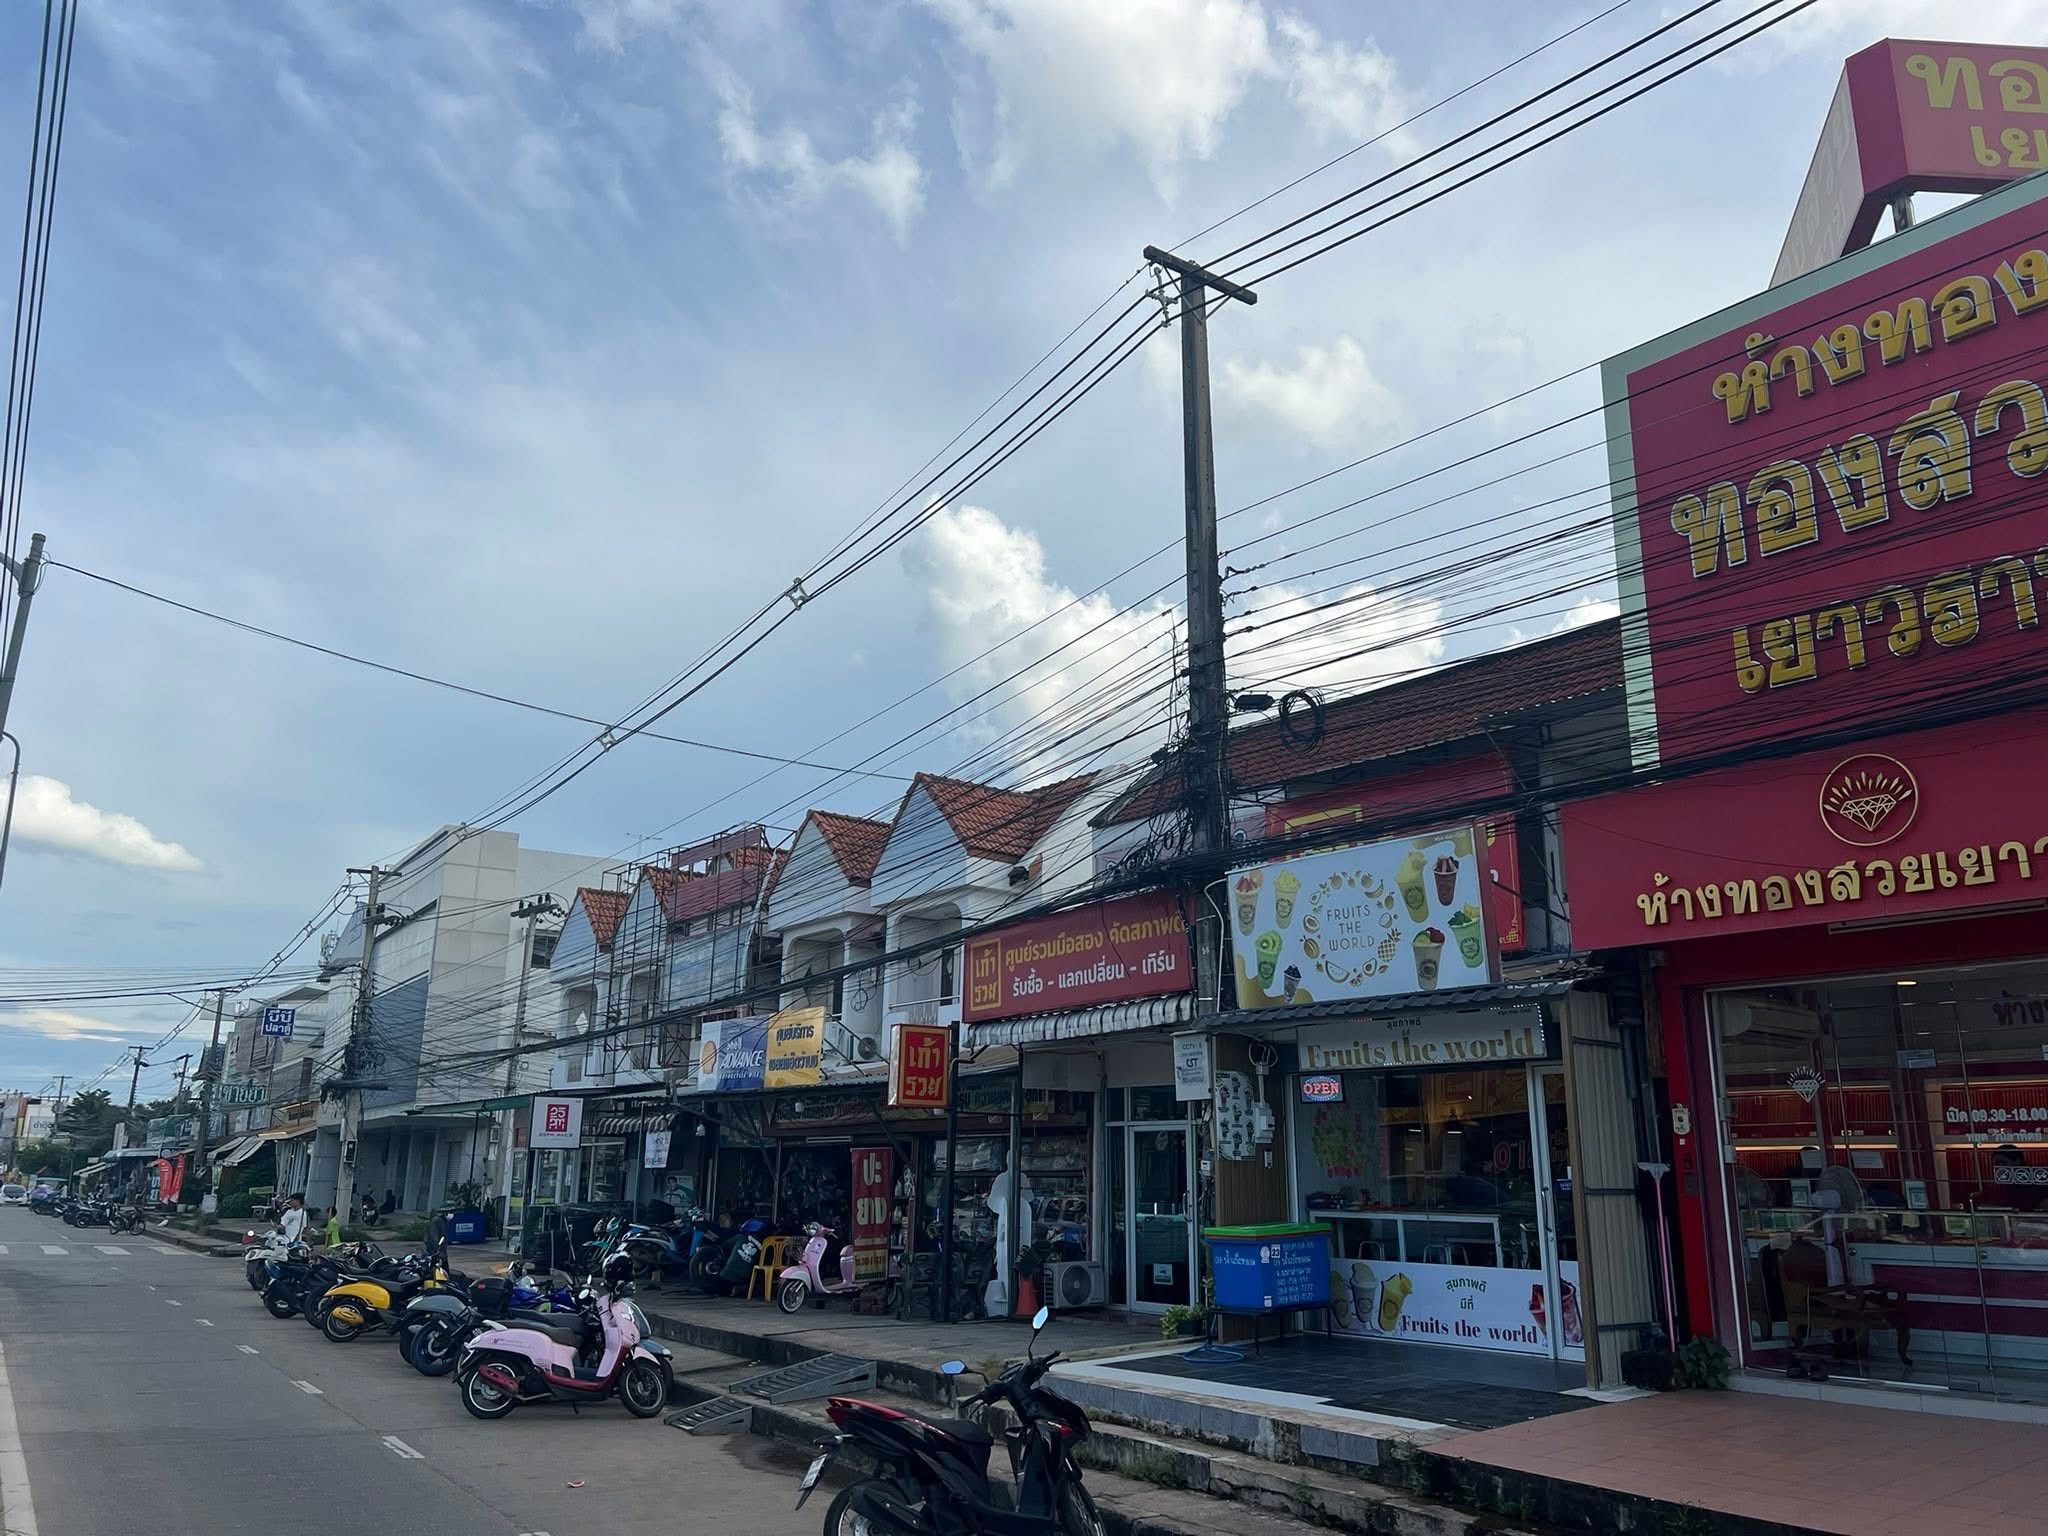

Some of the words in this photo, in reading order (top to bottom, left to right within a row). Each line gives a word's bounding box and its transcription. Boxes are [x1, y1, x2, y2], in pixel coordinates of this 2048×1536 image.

[1712, 249, 2048, 423] ห้างทอง
[1326, 904, 1371, 921] FRUITS
[1339, 921, 1361, 934] THE
[1328, 935, 1375, 952] WORLD
[1012, 968, 1043, 997] รับซื้อ
[1059, 955, 1125, 989] แลกเปลี่ยน
[1142, 950, 1175, 975] เทิร์น
[719, 1050, 764, 1069] ADVANCE
[909, 1038, 941, 1070] เก้า
[1307, 1041, 1385, 1070] Fruits
[1391, 1036, 1436, 1063] the
[1443, 1028, 1534, 1061] world
[1303, 1082, 1339, 1094] OPEN
[863, 1152, 882, 1186] ปะ
[1445, 1278, 1487, 1293] สุขภาพดี
[1401, 1315, 1449, 1336] Fruits
[1454, 1319, 1481, 1338] the
[1488, 1326, 1538, 1344] world
